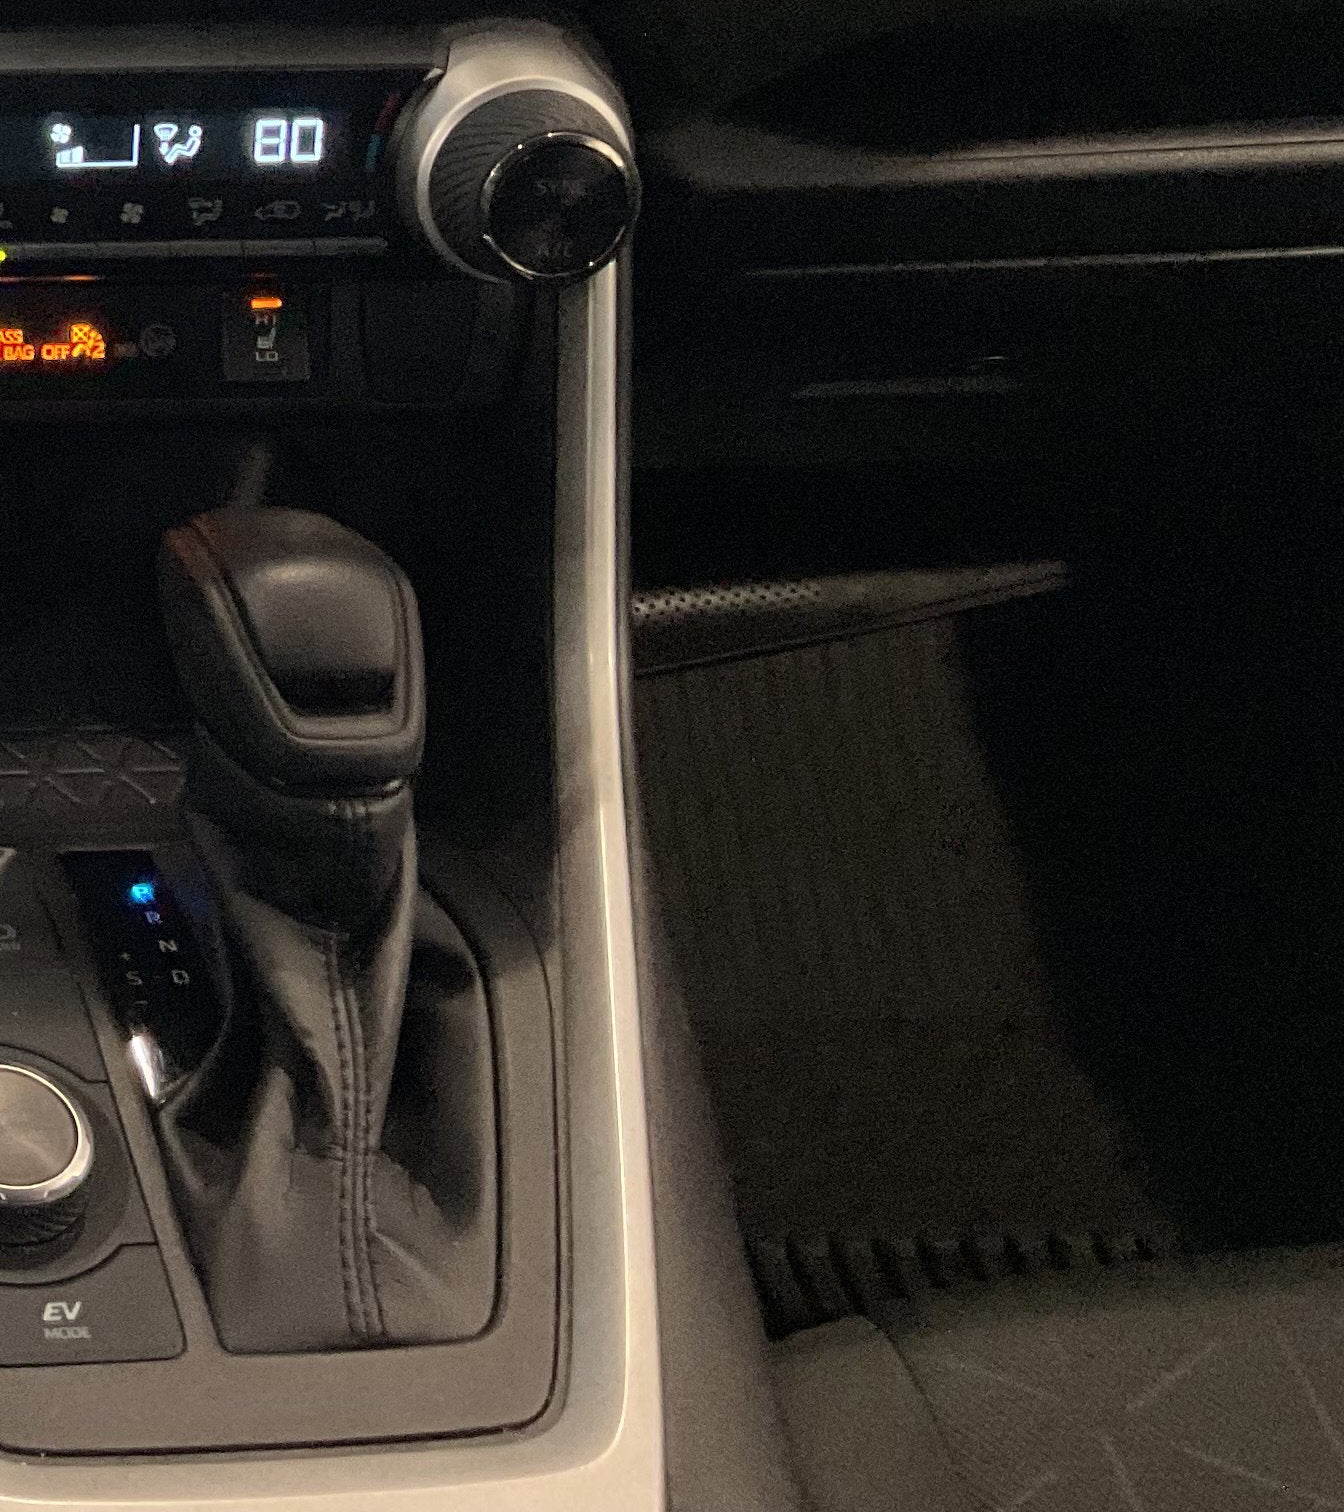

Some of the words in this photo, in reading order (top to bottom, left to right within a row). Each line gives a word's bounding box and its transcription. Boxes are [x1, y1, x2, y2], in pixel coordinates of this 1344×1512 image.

[253, 117, 324, 164] 80
[3, 345, 35, 360] BAG
[41, 345, 71, 360] OFF
[158, 938, 179, 953] N
[125, 970, 143, 986] S
[170, 969, 191, 985] D
[42, 1301, 82, 1321] EV
[43, 1326, 92, 1340] MODE
